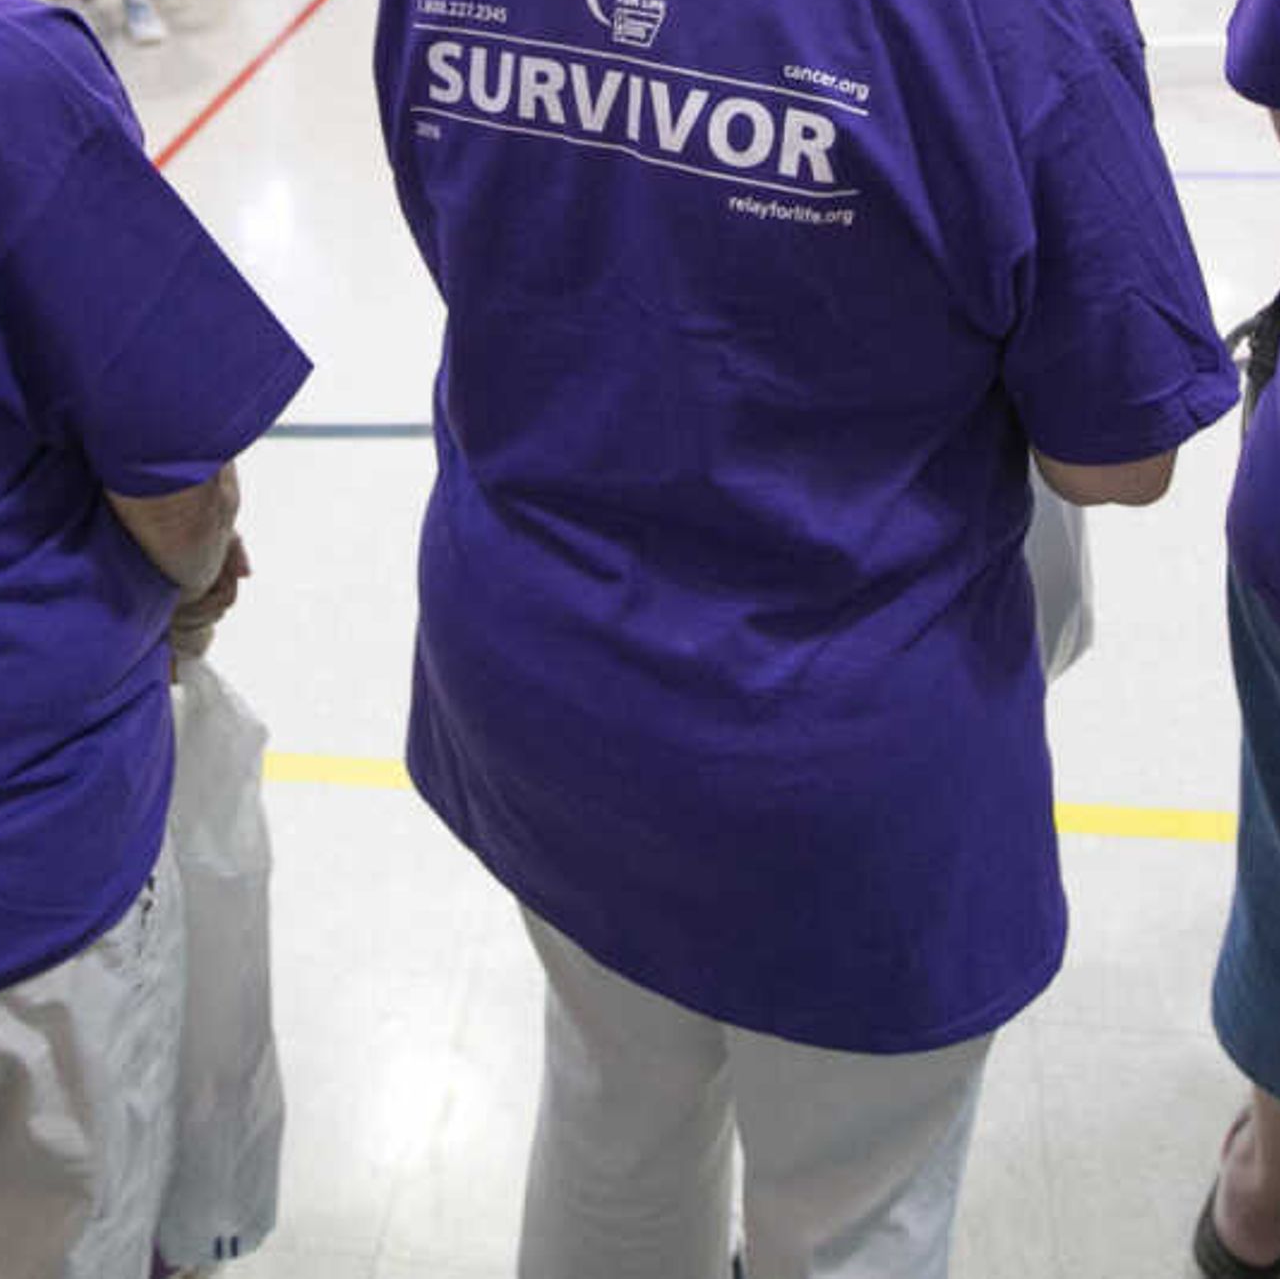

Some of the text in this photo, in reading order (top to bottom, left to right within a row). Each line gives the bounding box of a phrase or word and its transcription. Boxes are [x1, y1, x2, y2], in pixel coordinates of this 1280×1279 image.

[783, 64, 870, 102] cancer.org
[427, 40, 837, 183] SURVIVOR
[728, 196, 855, 226] relayforlife.org
